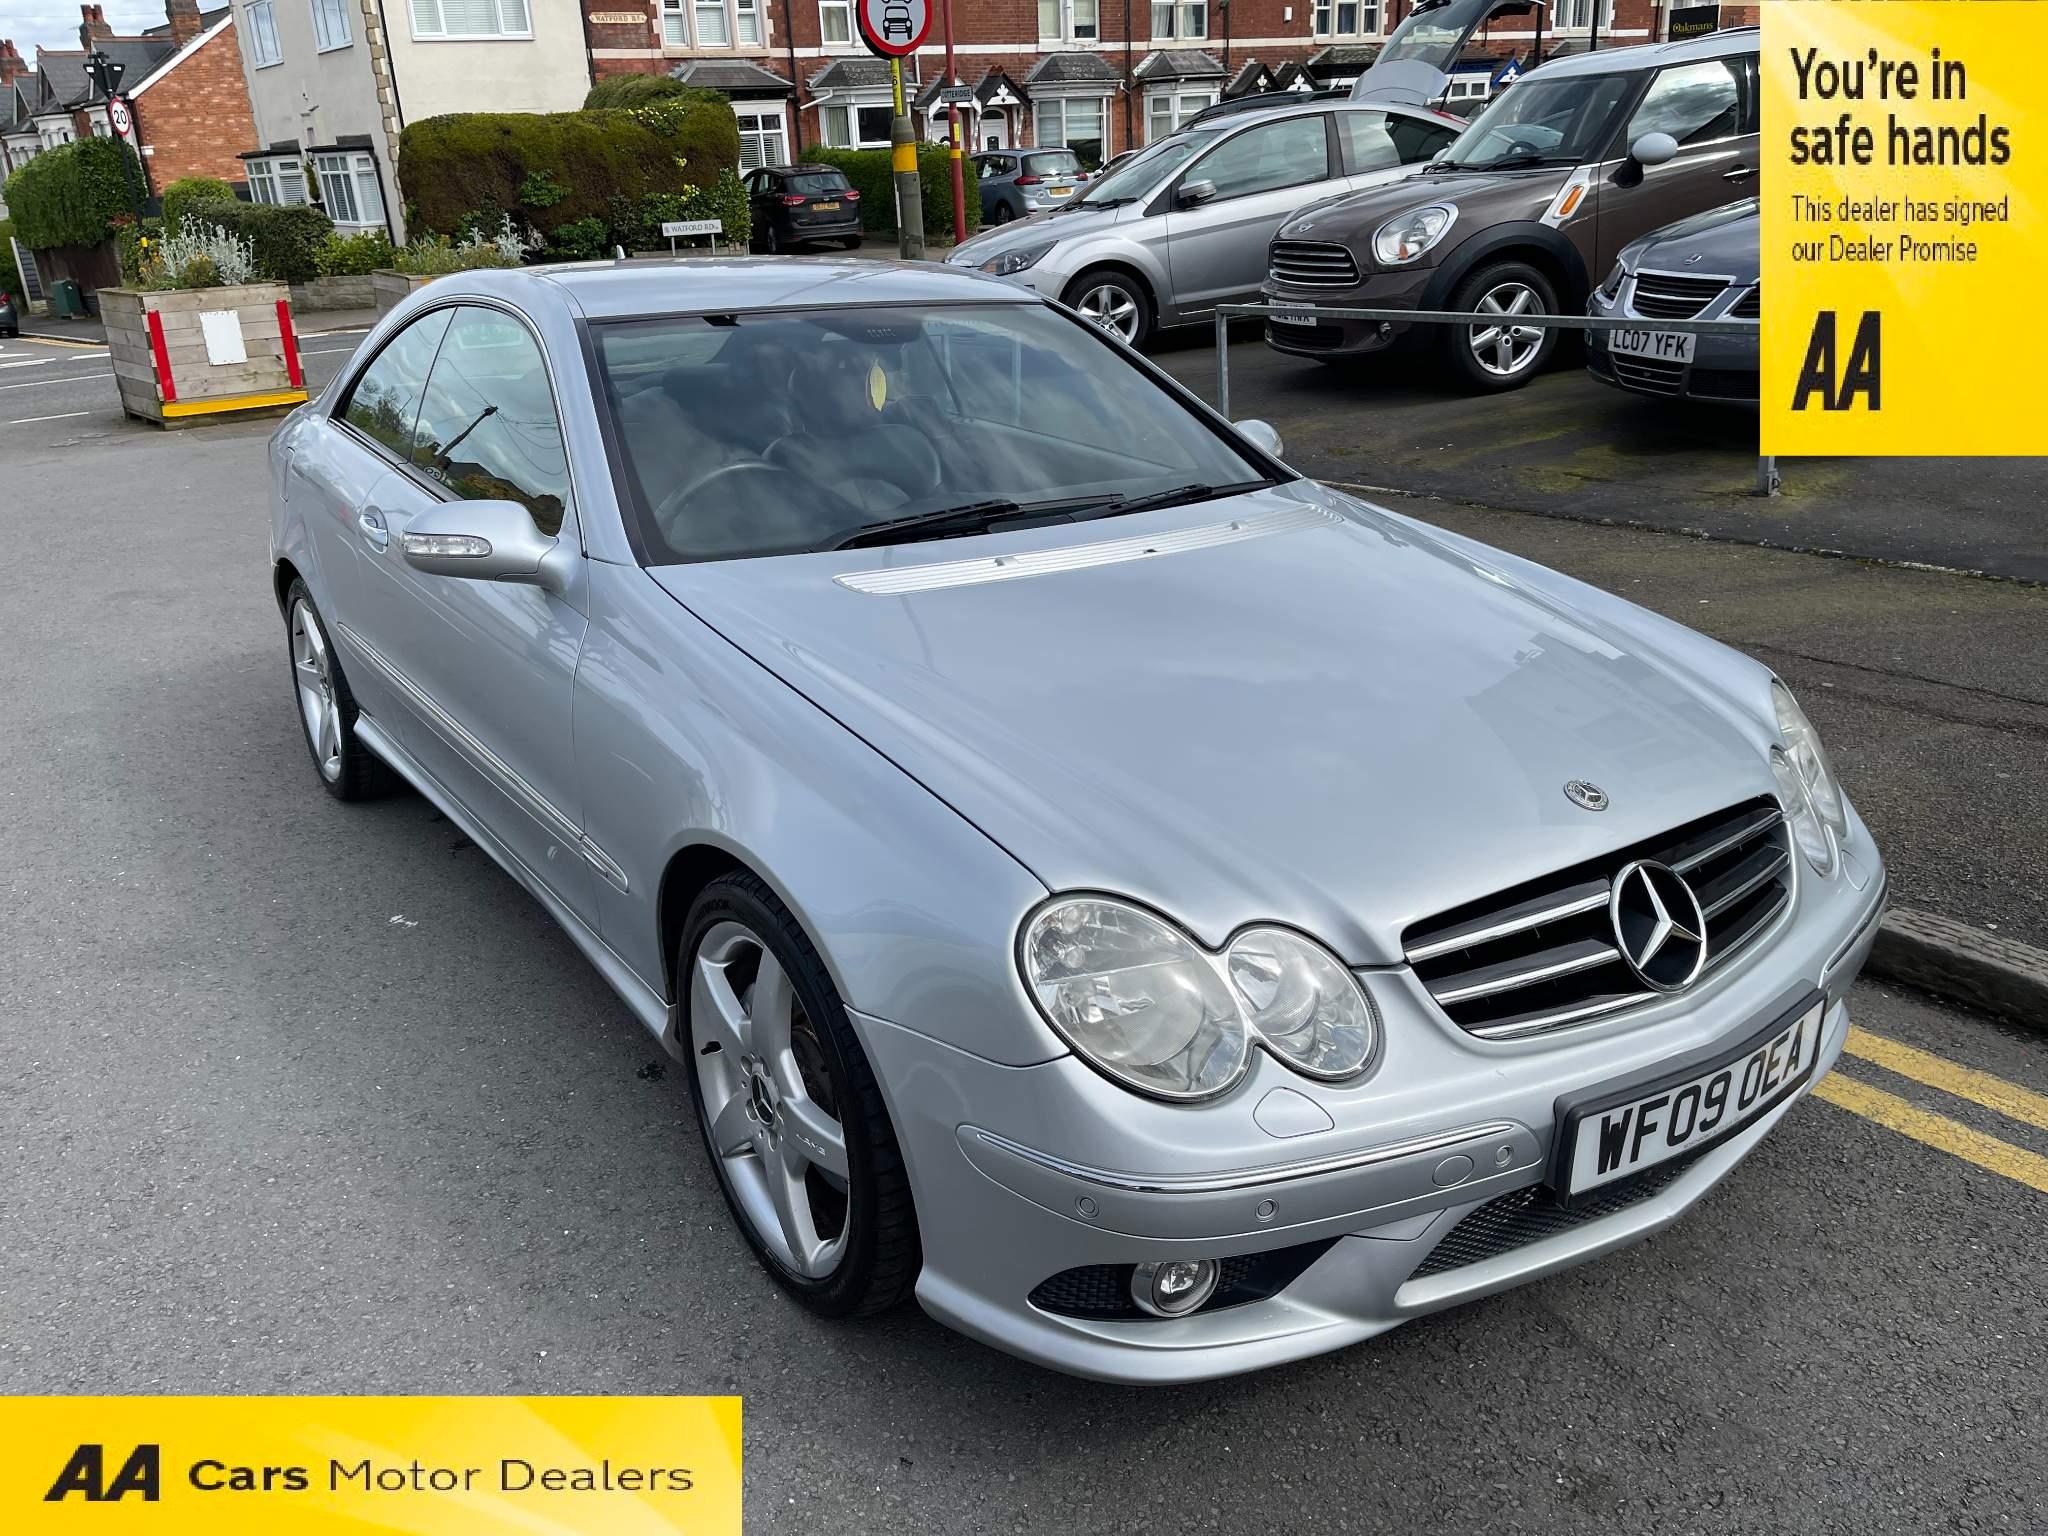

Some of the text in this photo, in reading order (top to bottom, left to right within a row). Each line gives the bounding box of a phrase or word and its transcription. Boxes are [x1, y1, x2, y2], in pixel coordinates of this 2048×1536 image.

[1672, 22, 1713, 33] Oakmans
[113, 109, 127, 124] 20
[671, 224, 703, 233] WATFORD
[704, 223, 714, 231] RD
[1613, 329, 1688, 358] LC07 YFK
[1597, 1019, 1803, 1175] WF09 OEA
